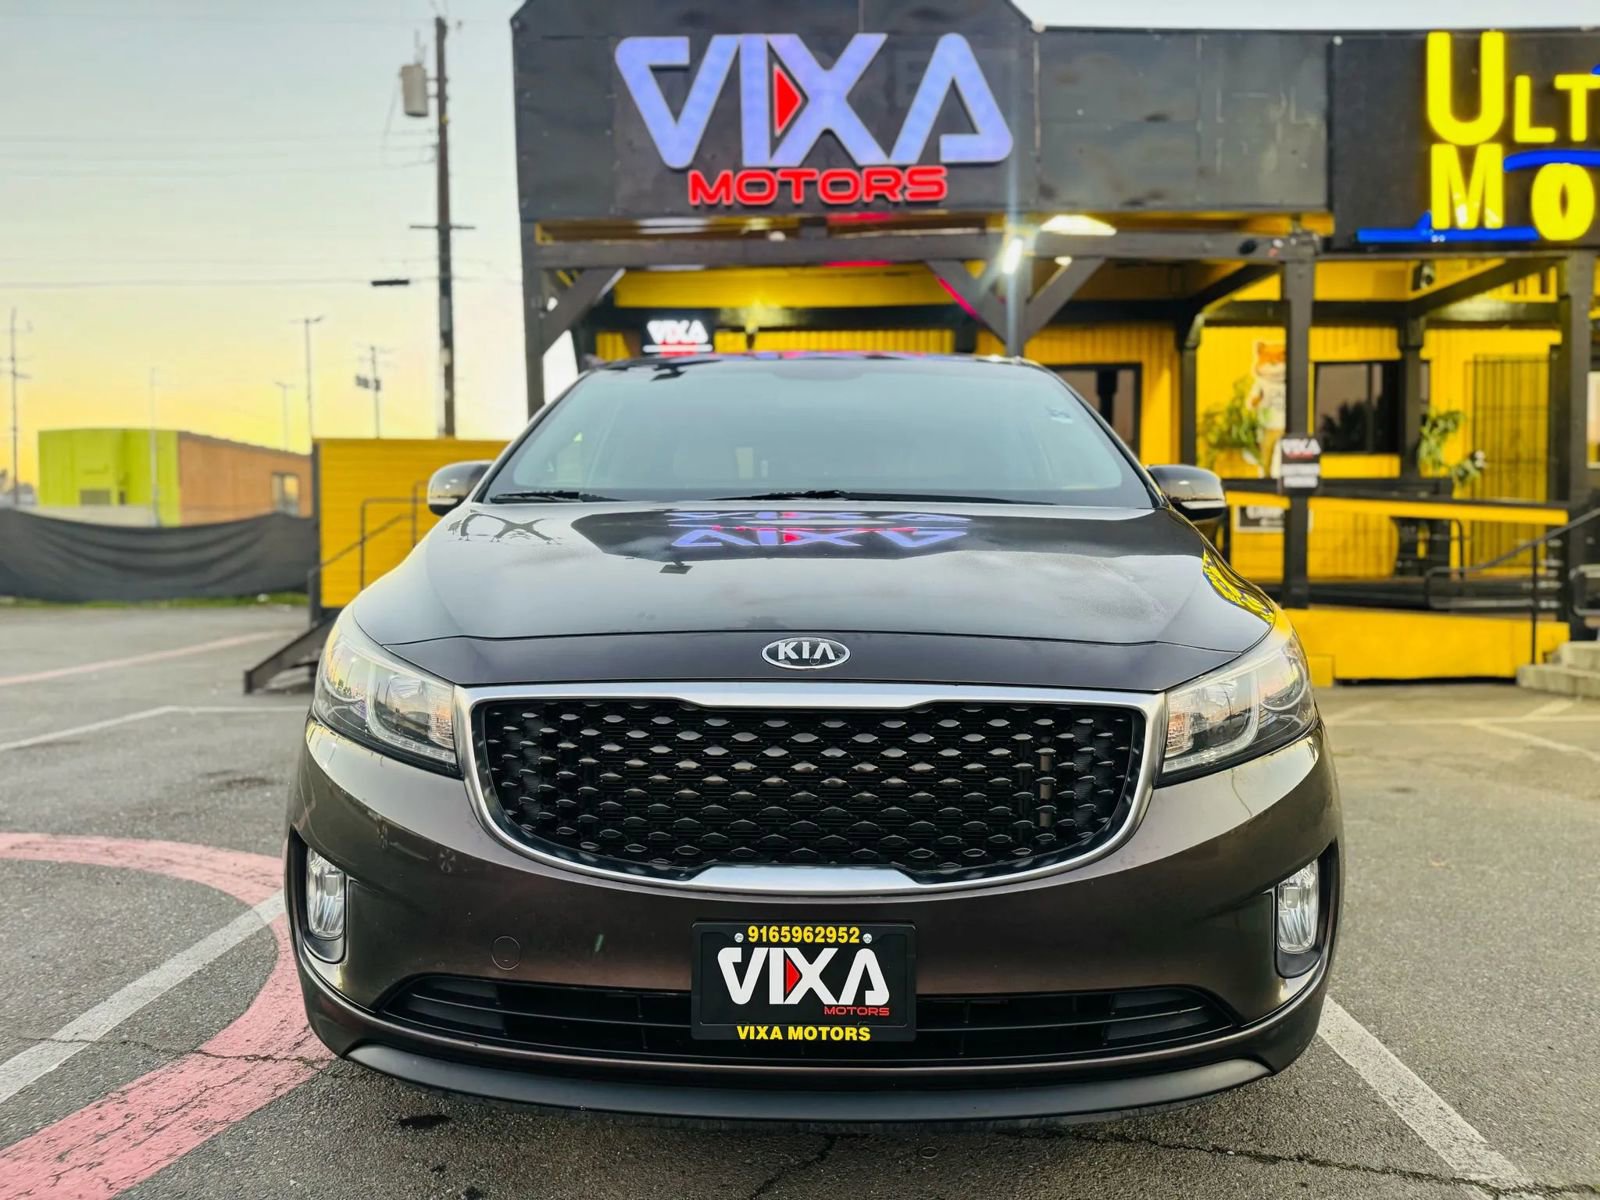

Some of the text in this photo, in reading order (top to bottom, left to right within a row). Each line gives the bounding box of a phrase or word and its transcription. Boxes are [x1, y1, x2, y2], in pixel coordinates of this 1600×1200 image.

[614, 32, 1014, 169] VIXA
[688, 165, 948, 206] MOTORS
[777, 641, 836, 660] KIA
[747, 925, 860, 943] 9165962952
[717, 947, 890, 1006] VIXA
[823, 1005, 890, 1017] MOTORS
[736, 1025, 871, 1041] VIXA MOTORS
